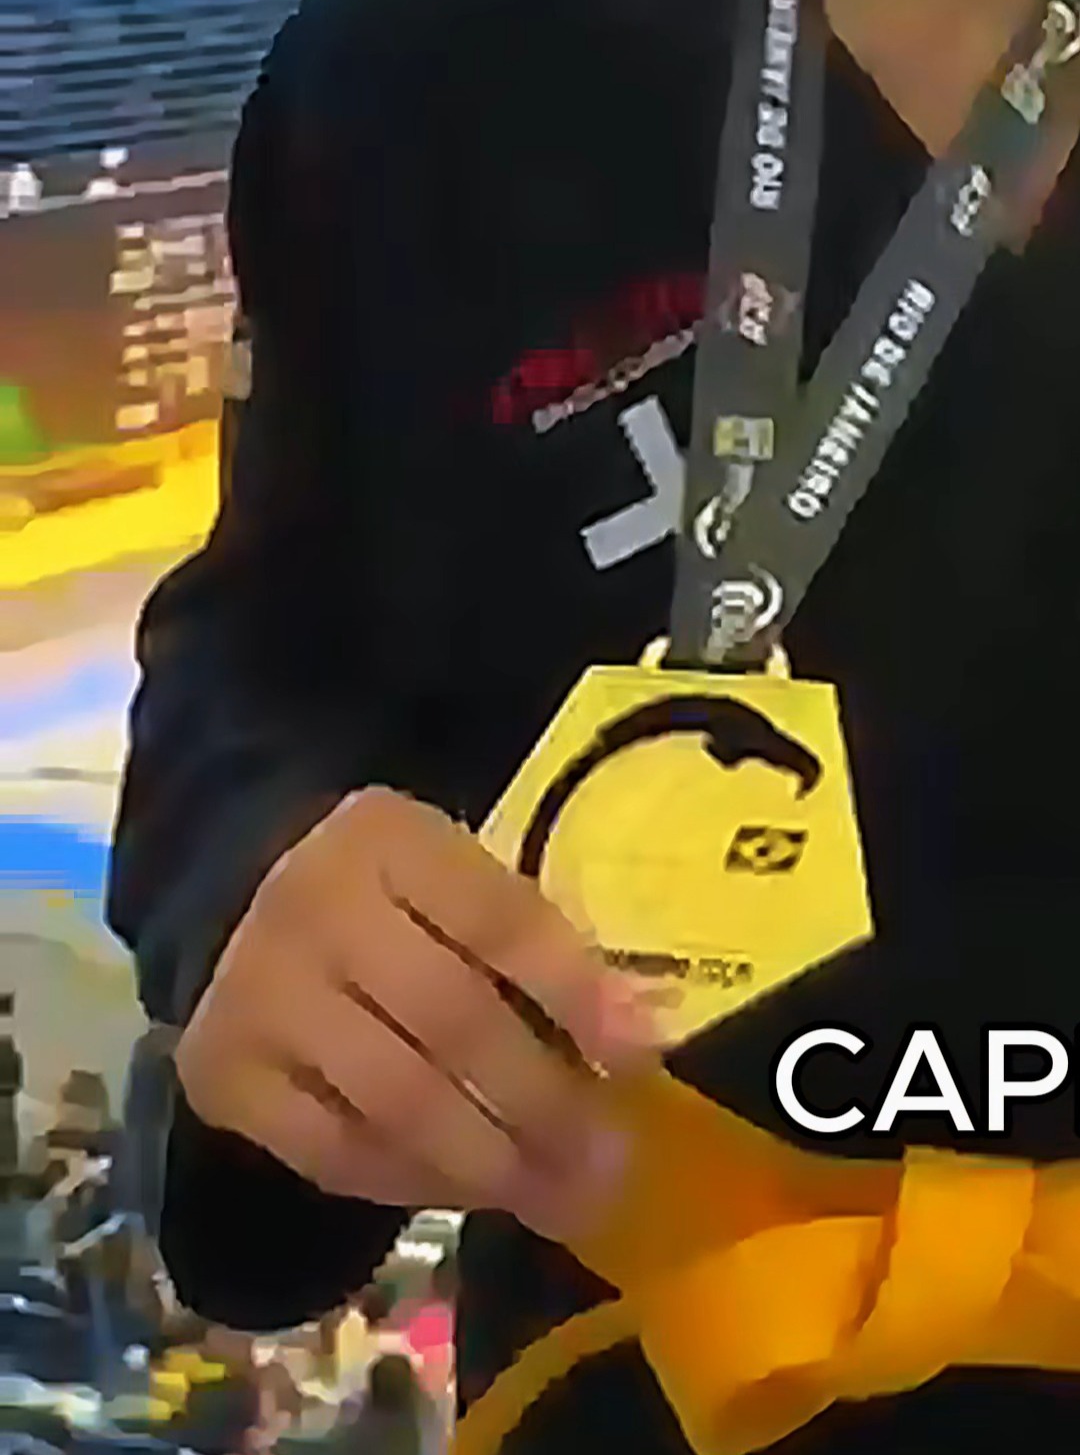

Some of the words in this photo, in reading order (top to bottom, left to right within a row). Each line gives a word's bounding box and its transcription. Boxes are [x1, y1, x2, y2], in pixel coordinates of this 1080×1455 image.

[750, 152, 784, 210] RIO
[889, 278, 935, 341] RIO
[861, 336, 906, 387] DE
[787, 381, 880, 519] JANEIRO
